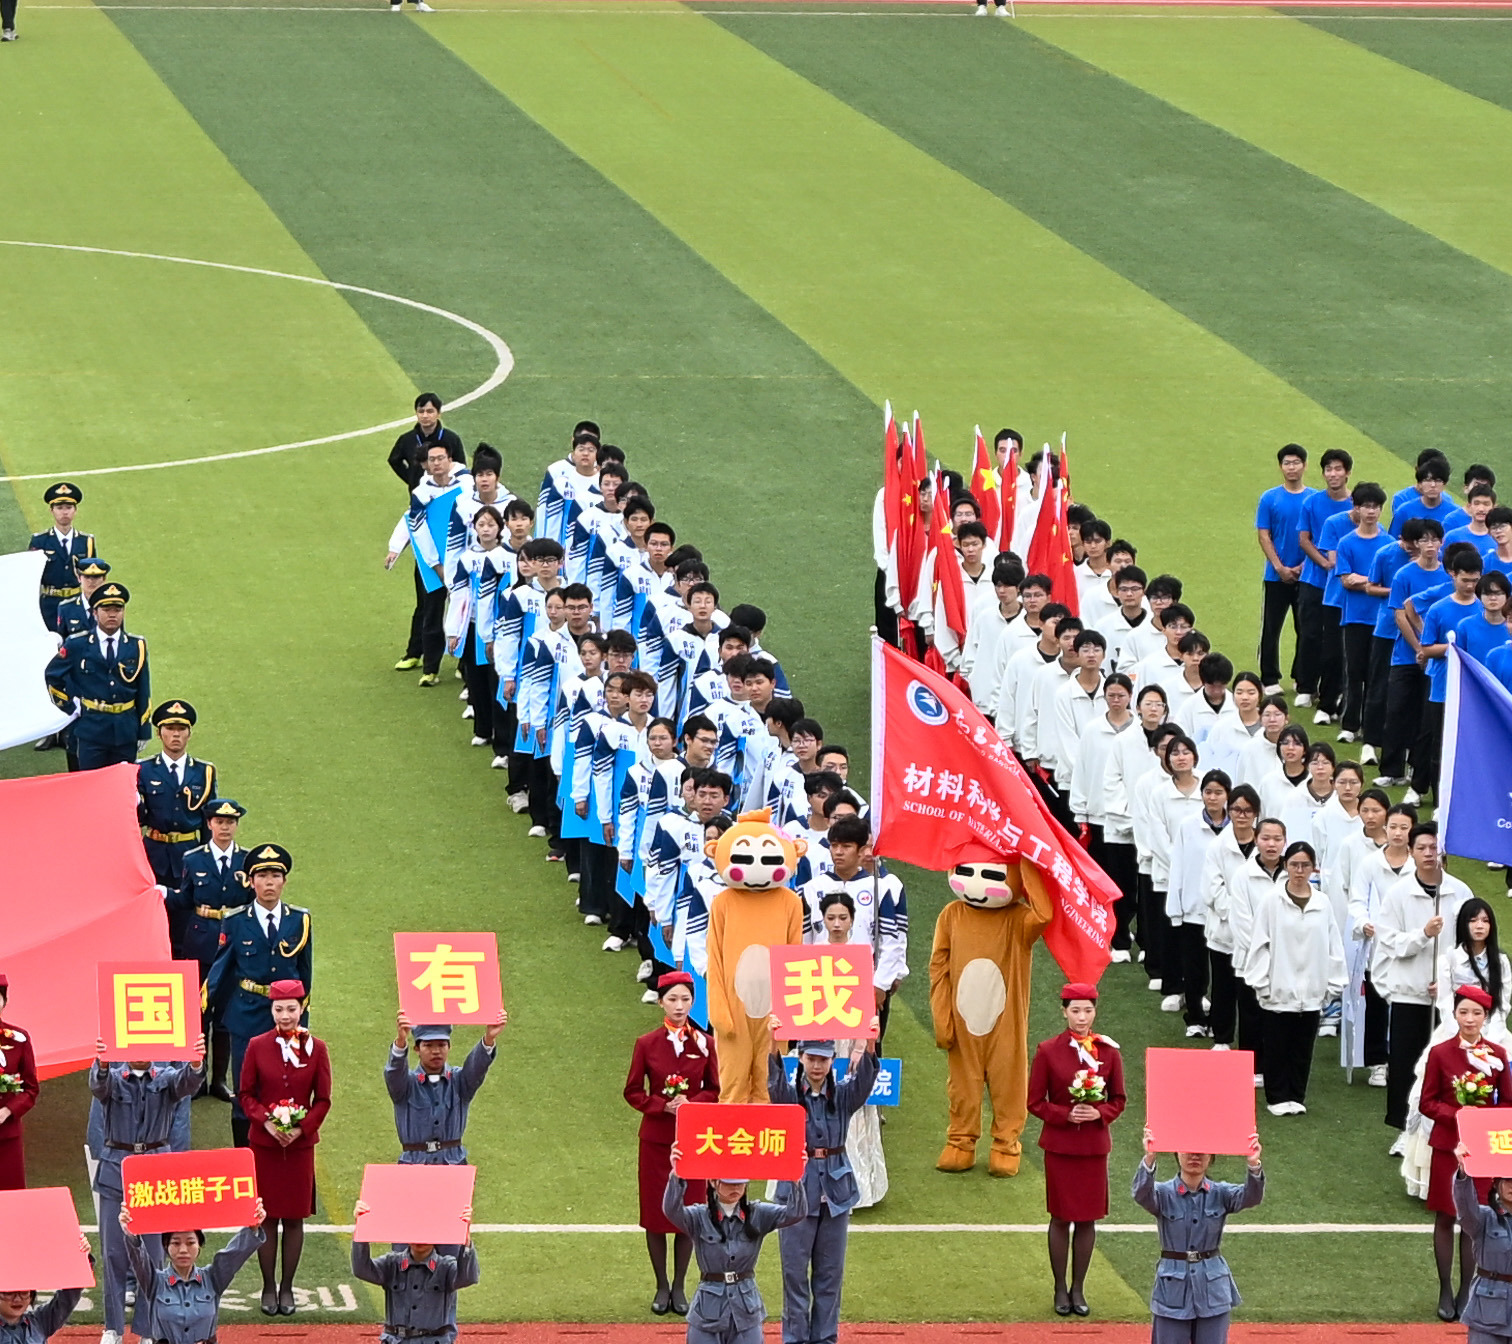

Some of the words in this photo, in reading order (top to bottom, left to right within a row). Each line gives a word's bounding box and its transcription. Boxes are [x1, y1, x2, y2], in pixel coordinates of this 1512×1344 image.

[903, 799, 946, 819] SCHOOL
[948, 809, 965, 824] OF
[903, 762, 1108, 933] 材料科学与工程学院
[113, 973, 187, 1048] 国
[410, 944, 486, 1013] 有
[784, 955, 863, 1027] 我
[696, 1126, 786, 1156] 大会师
[128, 1176, 255, 1209] 激战腊子口
